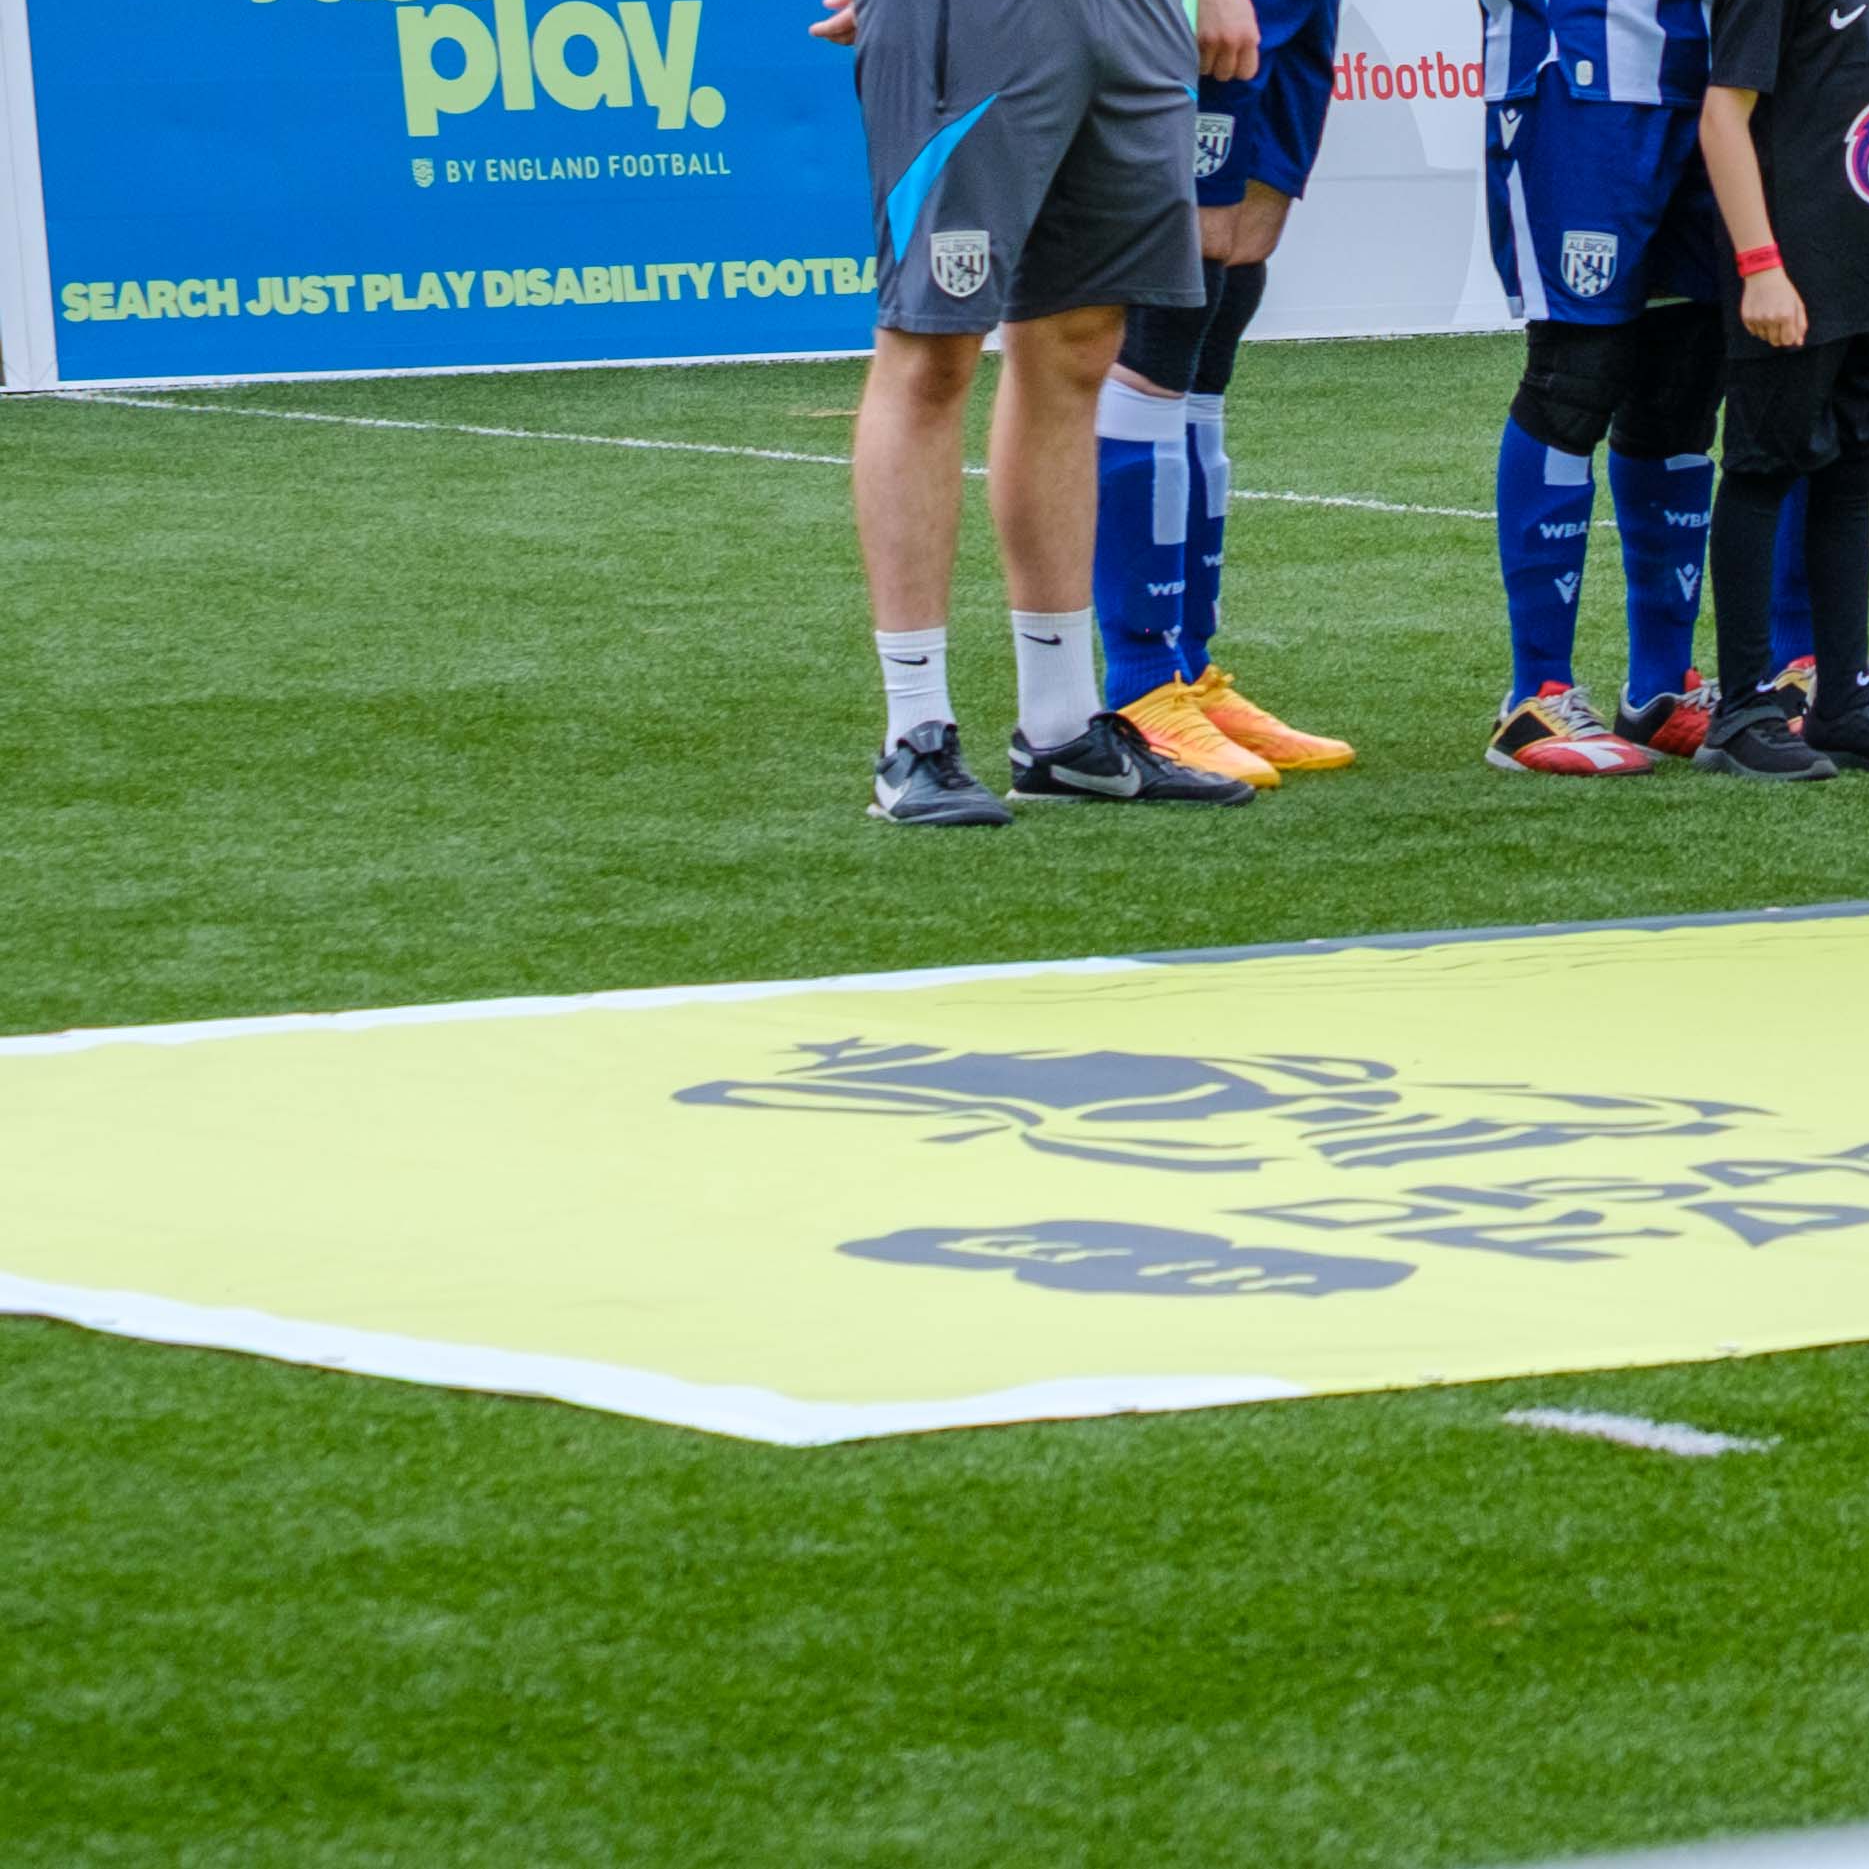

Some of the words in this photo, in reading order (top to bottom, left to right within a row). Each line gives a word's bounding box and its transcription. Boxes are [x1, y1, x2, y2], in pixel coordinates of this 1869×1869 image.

[446, 159, 476, 183] BY
[485, 156, 600, 182] ENGLAND
[608, 152, 731, 178] FOOTBALL
[62, 278, 240, 322] SEARCH
[245, 275, 356, 316] JUST
[362, 270, 476, 312] PLAY
[483, 262, 716, 308] DISABILITY
